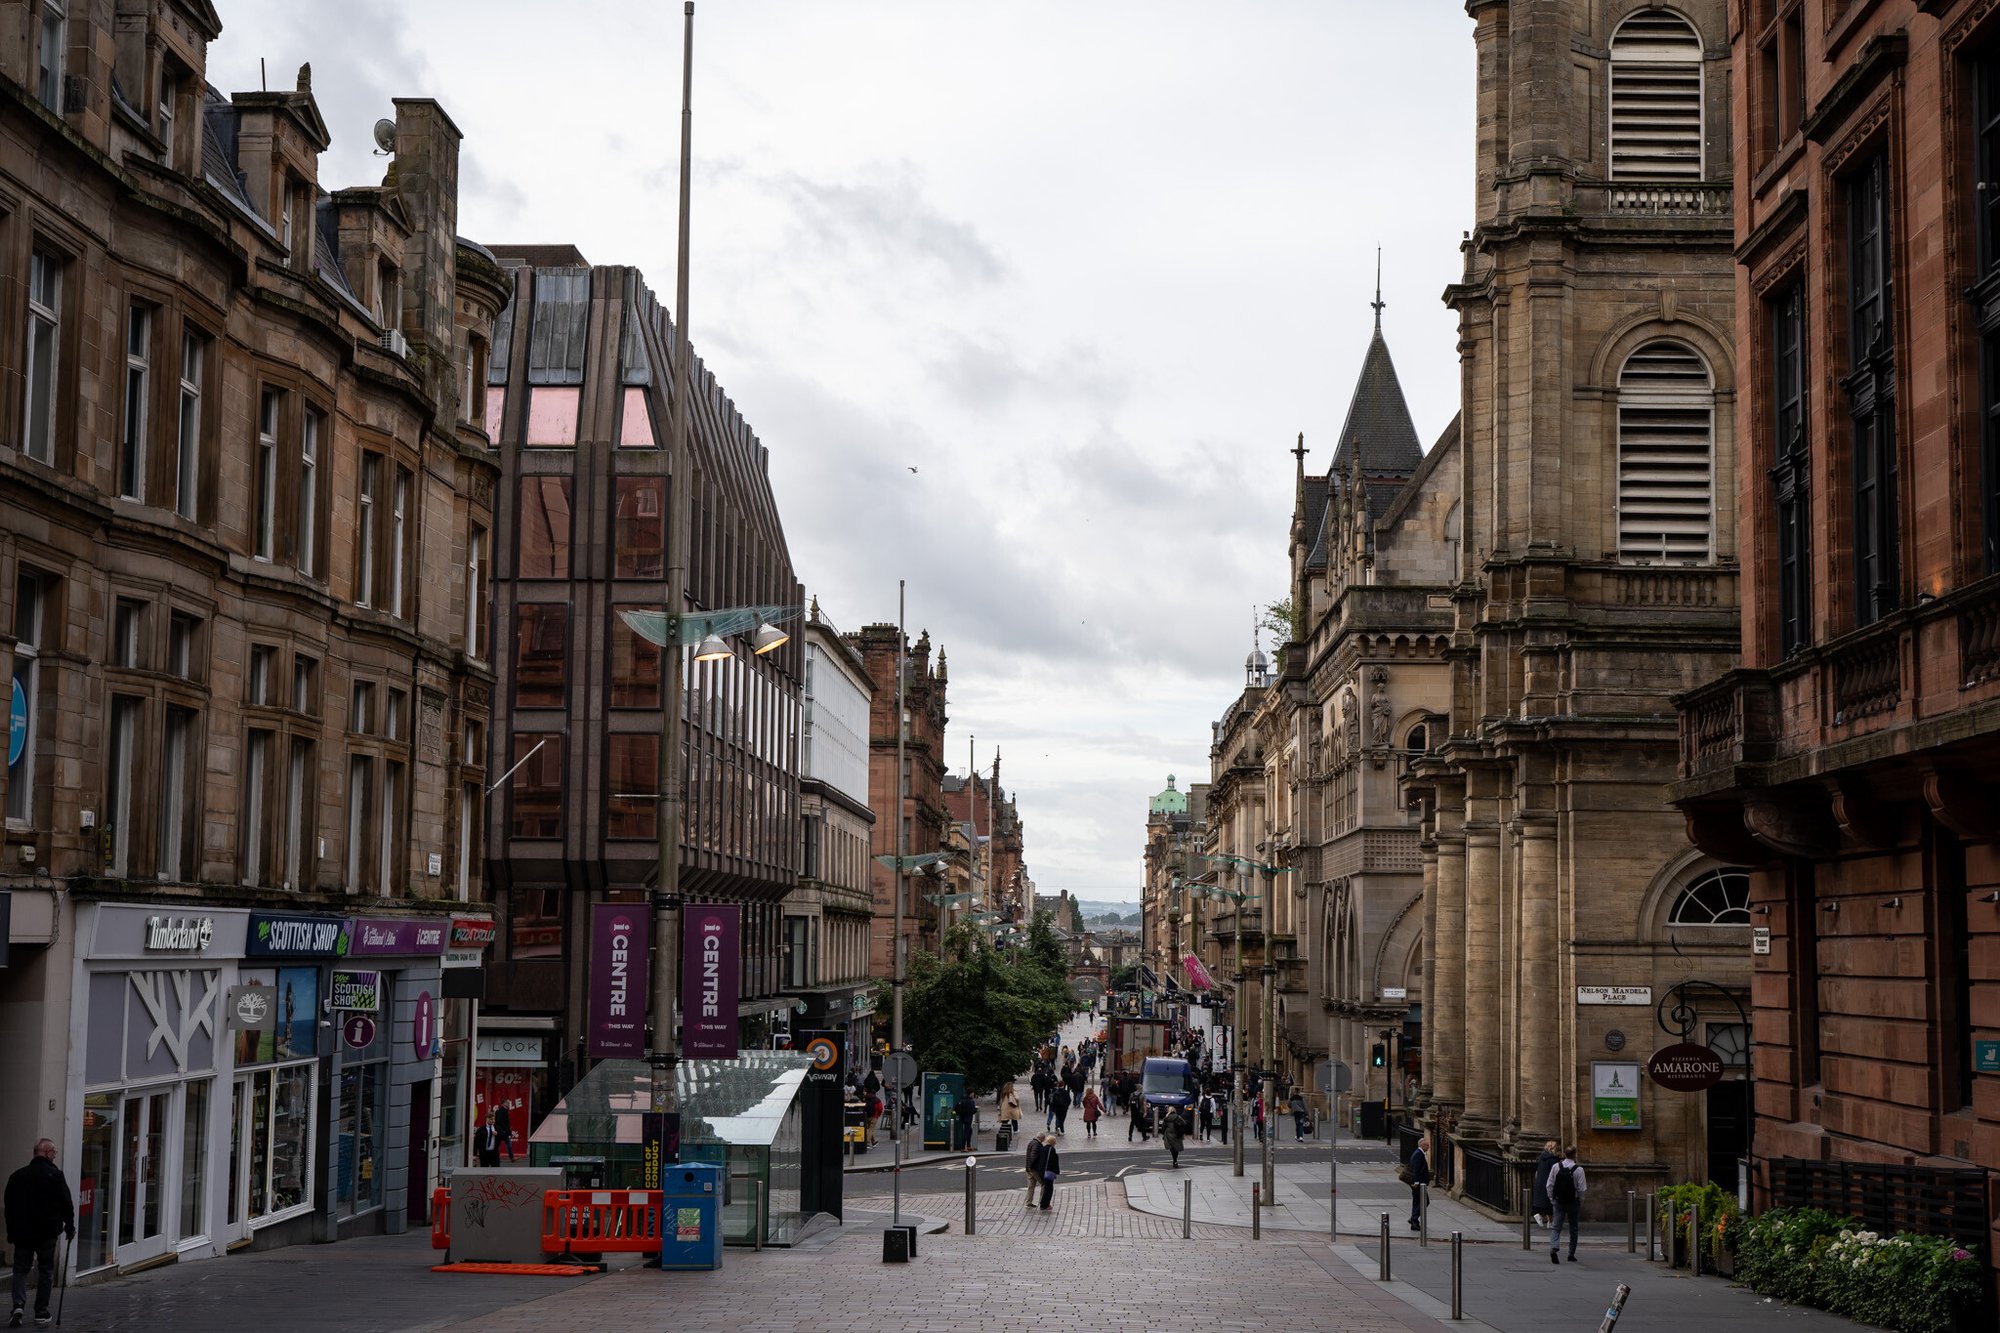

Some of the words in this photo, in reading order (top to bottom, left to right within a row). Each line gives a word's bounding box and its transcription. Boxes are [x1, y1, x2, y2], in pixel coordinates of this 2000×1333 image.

[150, 916, 201, 950] Timberland
[269, 921, 313, 951] SCOTTISH
[313, 923, 338, 951] SHOP
[334, 983, 375, 995] SCOTTISH
[334, 994, 357, 1006] SHOP
[492, 1042, 537, 1051] LOOK
[1653, 1062, 1720, 1073] AMARONE
[644, 1145, 652, 1160] OF
[651, 1138, 660, 1189] CONDUCT
[644, 1161, 652, 1189] CODE
